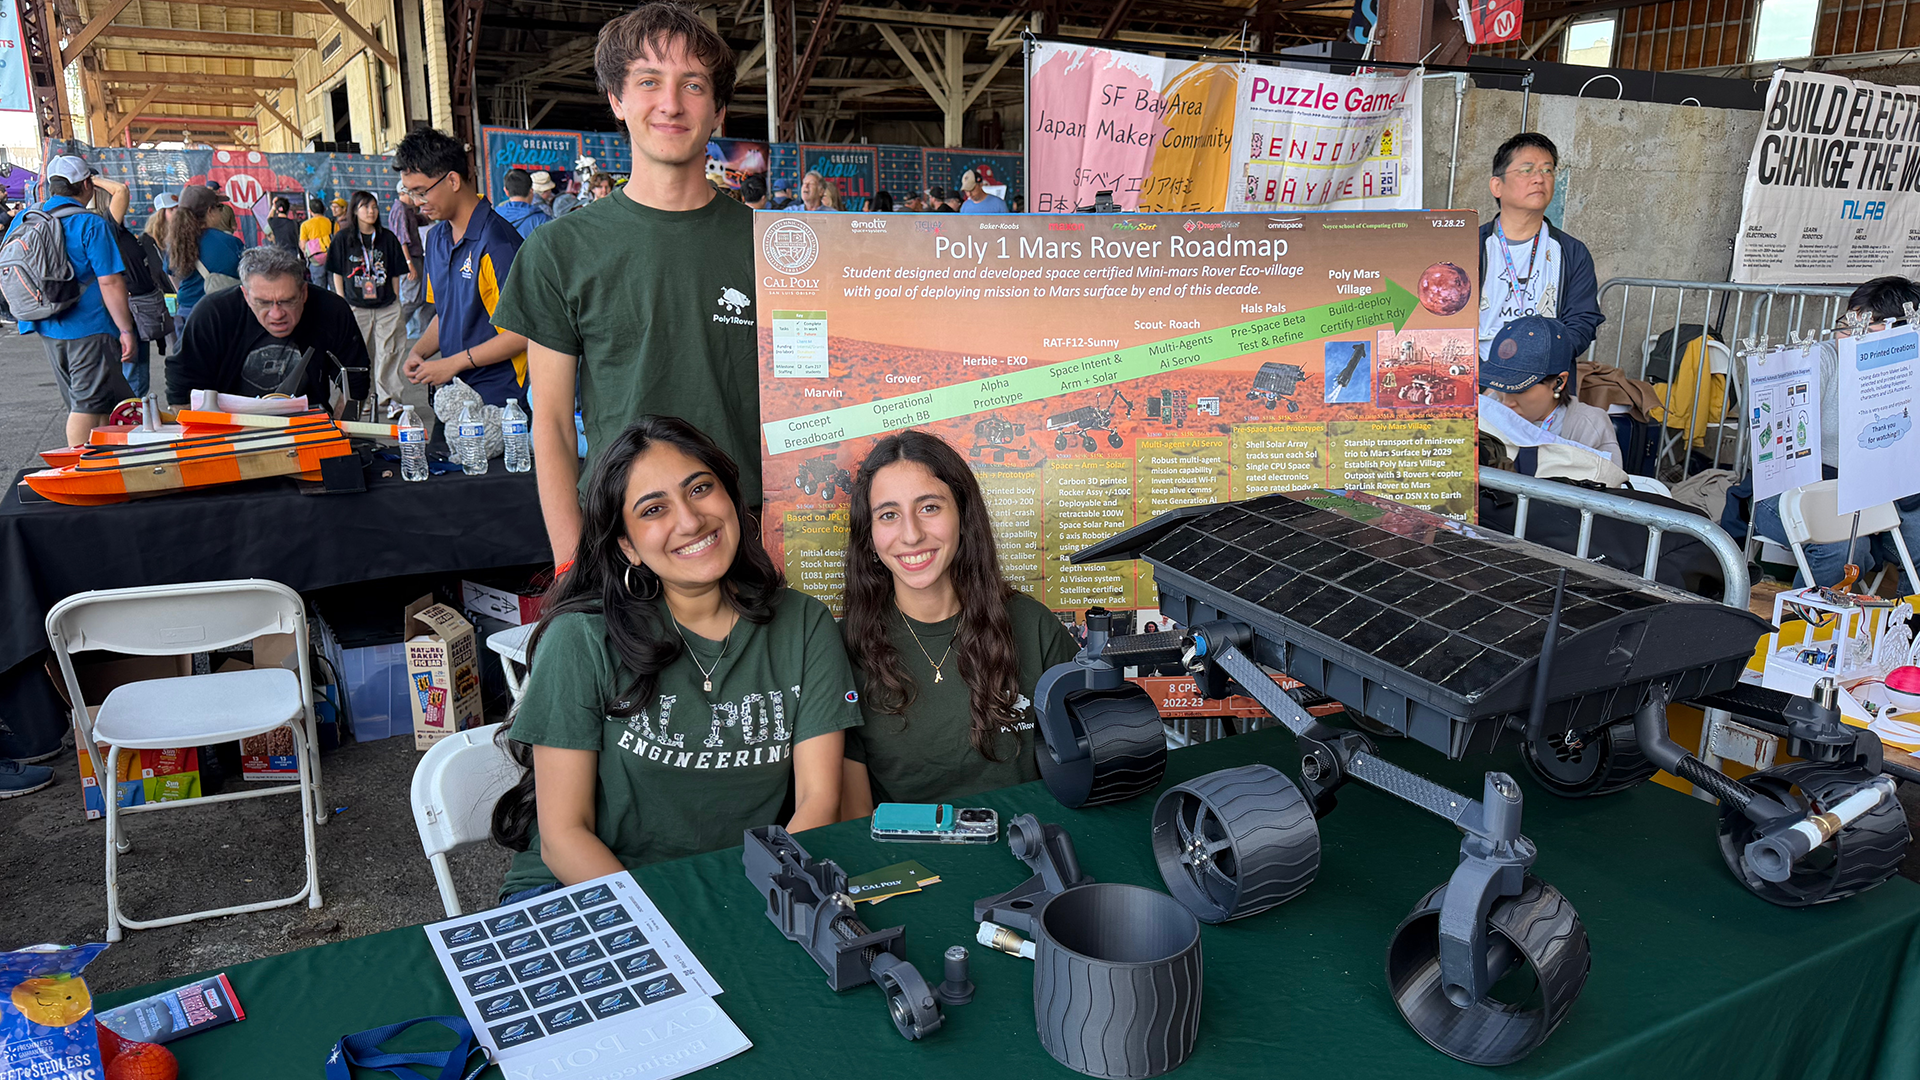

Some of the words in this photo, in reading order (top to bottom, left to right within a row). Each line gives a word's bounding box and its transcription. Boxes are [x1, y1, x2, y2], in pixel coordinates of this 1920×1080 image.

[1101, 84, 1127, 107] SF
[1250, 77, 1339, 111] Puzzle
[1766, 79, 1848, 136] BUILD
[1036, 110, 1086, 140] Japan
[1096, 119, 1156, 147] Maker
[1162, 127, 1233, 154] Community
[523, 139, 570, 151] GREATEST
[496, 140, 560, 168] Show
[831, 155, 868, 164] GREATEST
[811, 156, 860, 178] Show
[1758, 134, 1860, 190] CHANGE
[1857, 142, 1903, 191] THE
[230, 180, 258, 203] M
[1048, 223, 1085, 231] maxon
[1267, 222, 1303, 230] omnispace
[1362, 222, 1391, 231] Computing
[1432, 219, 1465, 228] V3.28.25
[935, 236, 988, 265] Poly
[997, 237, 1011, 259] 1
[1020, 237, 1082, 258] Mars
[1091, 237, 1162, 258] Rover
[1170, 234, 1288, 262] Roadmap
[843, 266, 891, 278] Student
[895, 266, 950, 281] designed
[953, 266, 978, 278] and
[980, 266, 1043, 281] developed
[1045, 269, 1080, 281] space
[1083, 265, 1133, 279] certified
[1137, 265, 1199, 278] Mini-mars
[1202, 265, 1237, 277] Rover
[1239, 263, 1304, 278] Eco-village
[1328, 270, 1351, 281] Poly
[1353, 269, 1380, 279] Mars
[763, 276, 788, 288] CAL
[789, 277, 820, 288] POLY
[844, 284, 871, 297] with
[874, 285, 901, 300] goal
[905, 285, 919, 300] of
[921, 285, 981, 300] deploying
[984, 285, 1030, 297] mission
[1033, 286, 1046, 297] to
[1049, 286, 1081, 297] Mars
[1084, 284, 1128, 299] surface
[1131, 284, 1146, 299] by
[1148, 284, 1171, 296] end
[1174, 283, 1188, 298] of
[1190, 283, 1212, 296] this
[1215, 283, 1261, 295] decade.
[1336, 285, 1372, 296] Village
[1241, 303, 1263, 313] Hals
[1265, 303, 1286, 312] Pals
[1328, 297, 1392, 317] Build-deploy
[713, 314, 755, 326] Poly1Rover
[1134, 320, 1166, 330] Scout-
[1169, 319, 1200, 329] Roach
[1230, 322, 1280, 338] Pre-Space
[1283, 314, 1306, 326] Beta
[1319, 319, 1353, 334] Certify
[1356, 313, 1385, 326] Flight
[1387, 307, 1406, 321] Rdy
[1043, 337, 1119, 349] RAT-F12-Sunny
[1149, 334, 1214, 356] Multi-Agents
[1238, 341, 1259, 352] Test
[1261, 337, 1270, 346] &
[1272, 331, 1304, 344] Refine
[1860, 352, 1869, 362] 3D
[1869, 348, 1890, 359] Printed
[1891, 342, 1916, 355] Creations
[963, 356, 998, 365] Herbie
[1007, 356, 1028, 365] EXO
[1050, 364, 1080, 378] Space
[1082, 357, 1111, 371] Intent
[1114, 353, 1122, 363] &
[1160, 359, 1171, 369] Ai
[1172, 353, 1201, 367] Servo
[885, 374, 922, 383] Grover
[1060, 380, 1081, 391] Arm
[1093, 371, 1118, 385] Solar
[980, 379, 1010, 392] Alpha
[1489, 381, 1505, 389] SAN
[804, 388, 843, 397] Marvin
[873, 394, 934, 415] Operational
[973, 392, 1023, 409] Prototype
[788, 415, 831, 432] Concept
[882, 411, 914, 428] Bench
[916, 410, 931, 420] BB
[1872, 424, 1887, 433] Thank
[1887, 422, 1896, 431] you
[784, 428, 845, 448] Breadboard
[1377, 439, 1414, 447] transport
[1867, 436, 1876, 444] for
[1287, 440, 1308, 449] Array
[1422, 448, 1431, 456] by
[1433, 448, 1452, 456] 2029
[1179, 456, 1221, 464] multi-agent
[1058, 477, 1085, 485] Carbon
[1087, 477, 1098, 485] 3D
[1100, 476, 1127, 486] printed
[787, 513, 814, 521] Based
[828, 513, 841, 521] JPL
[801, 572, 823, 580] (1081
[1060, 585, 1090, 593] Satellite
[1092, 585, 1123, 593] certified
[1169, 684, 1175, 692] 8
[1178, 683, 1197, 692] CPE
[1162, 698, 1204, 708] 2022-23
[617, 730, 791, 769] ENGINEERING
[881, 880, 902, 888] POLY
[452, 934, 480, 944] POLYSPACE
[475, 979, 505, 990] POLYSPACE
[488, 1004, 520, 1016] POLYSPACE
[502, 1031, 534, 1043] POLYSPACE
[16, 1039, 54, 1053] FRESHNESS
[31, 1053, 91, 1079] SEEDLESS
